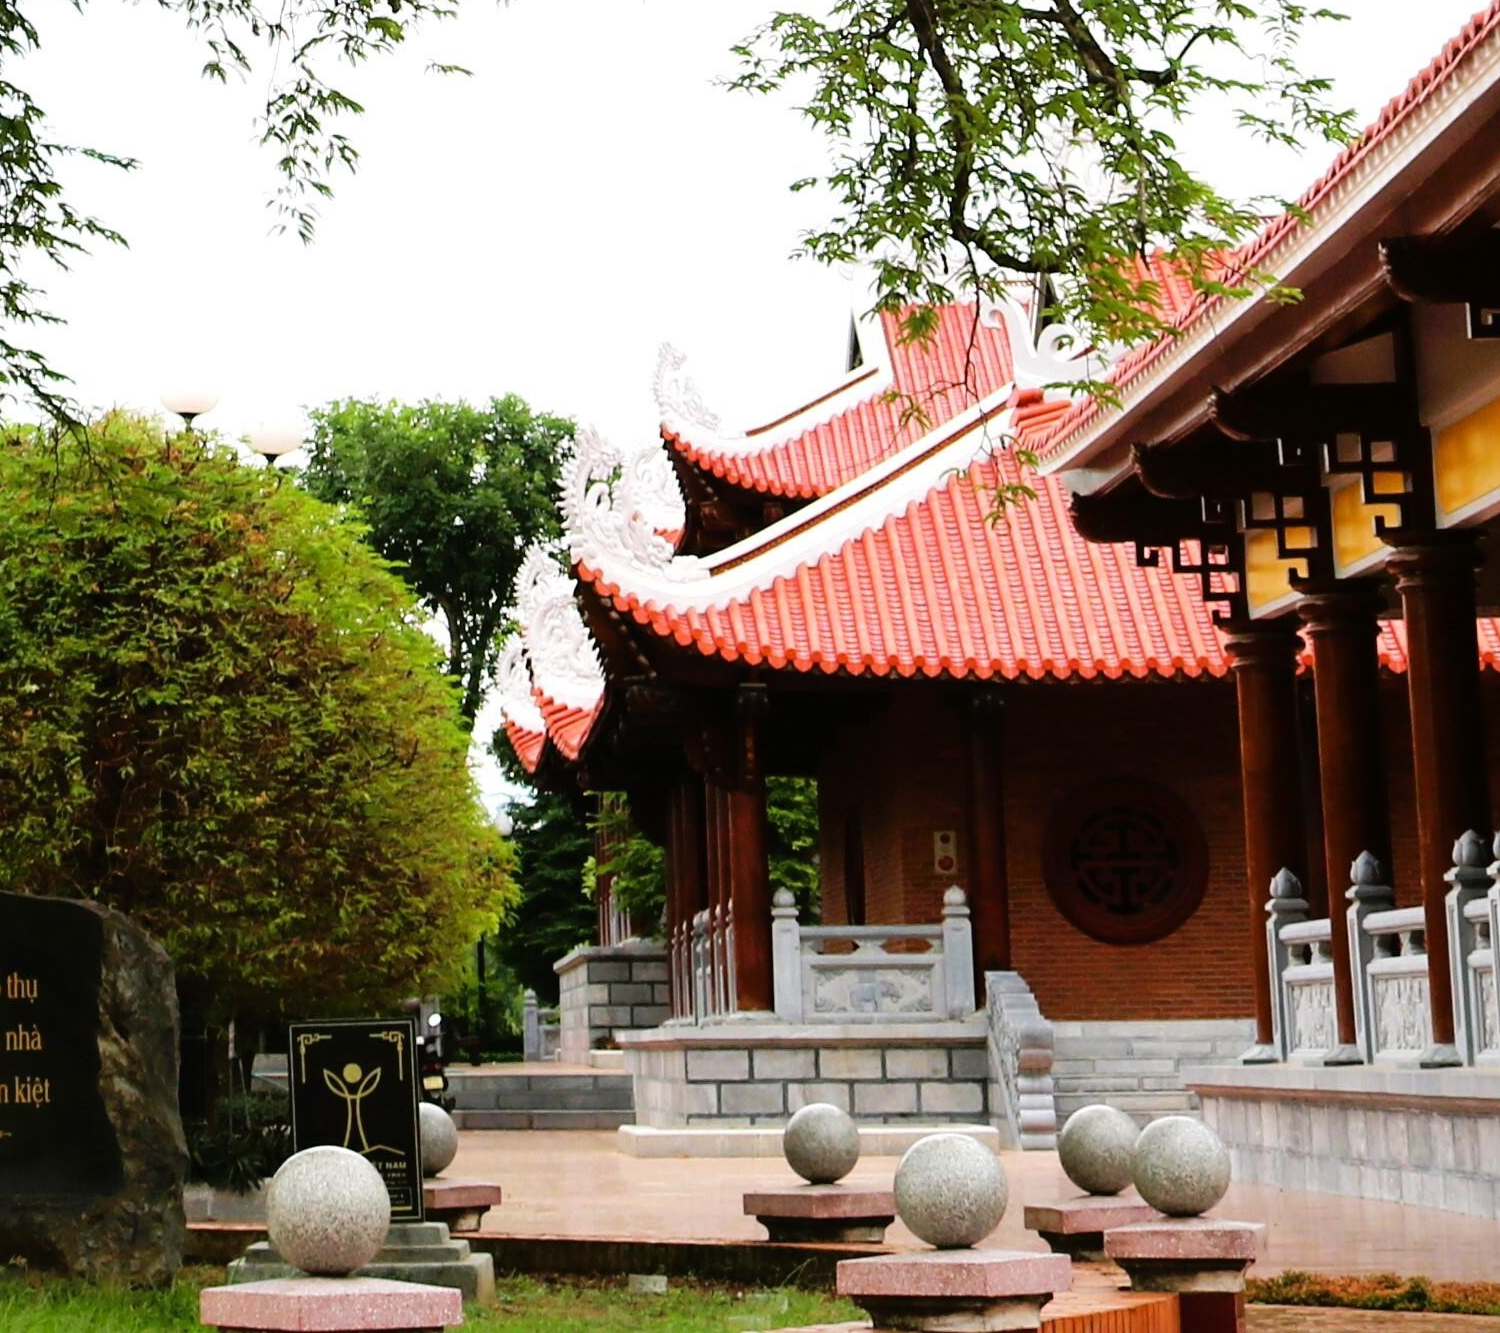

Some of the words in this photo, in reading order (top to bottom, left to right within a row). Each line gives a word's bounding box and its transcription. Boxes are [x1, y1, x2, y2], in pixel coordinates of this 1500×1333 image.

[7, 972, 38, 1004] thụ
[5, 1024, 42, 1051] nhà
[15, 1076, 50, 1108] kiệt
